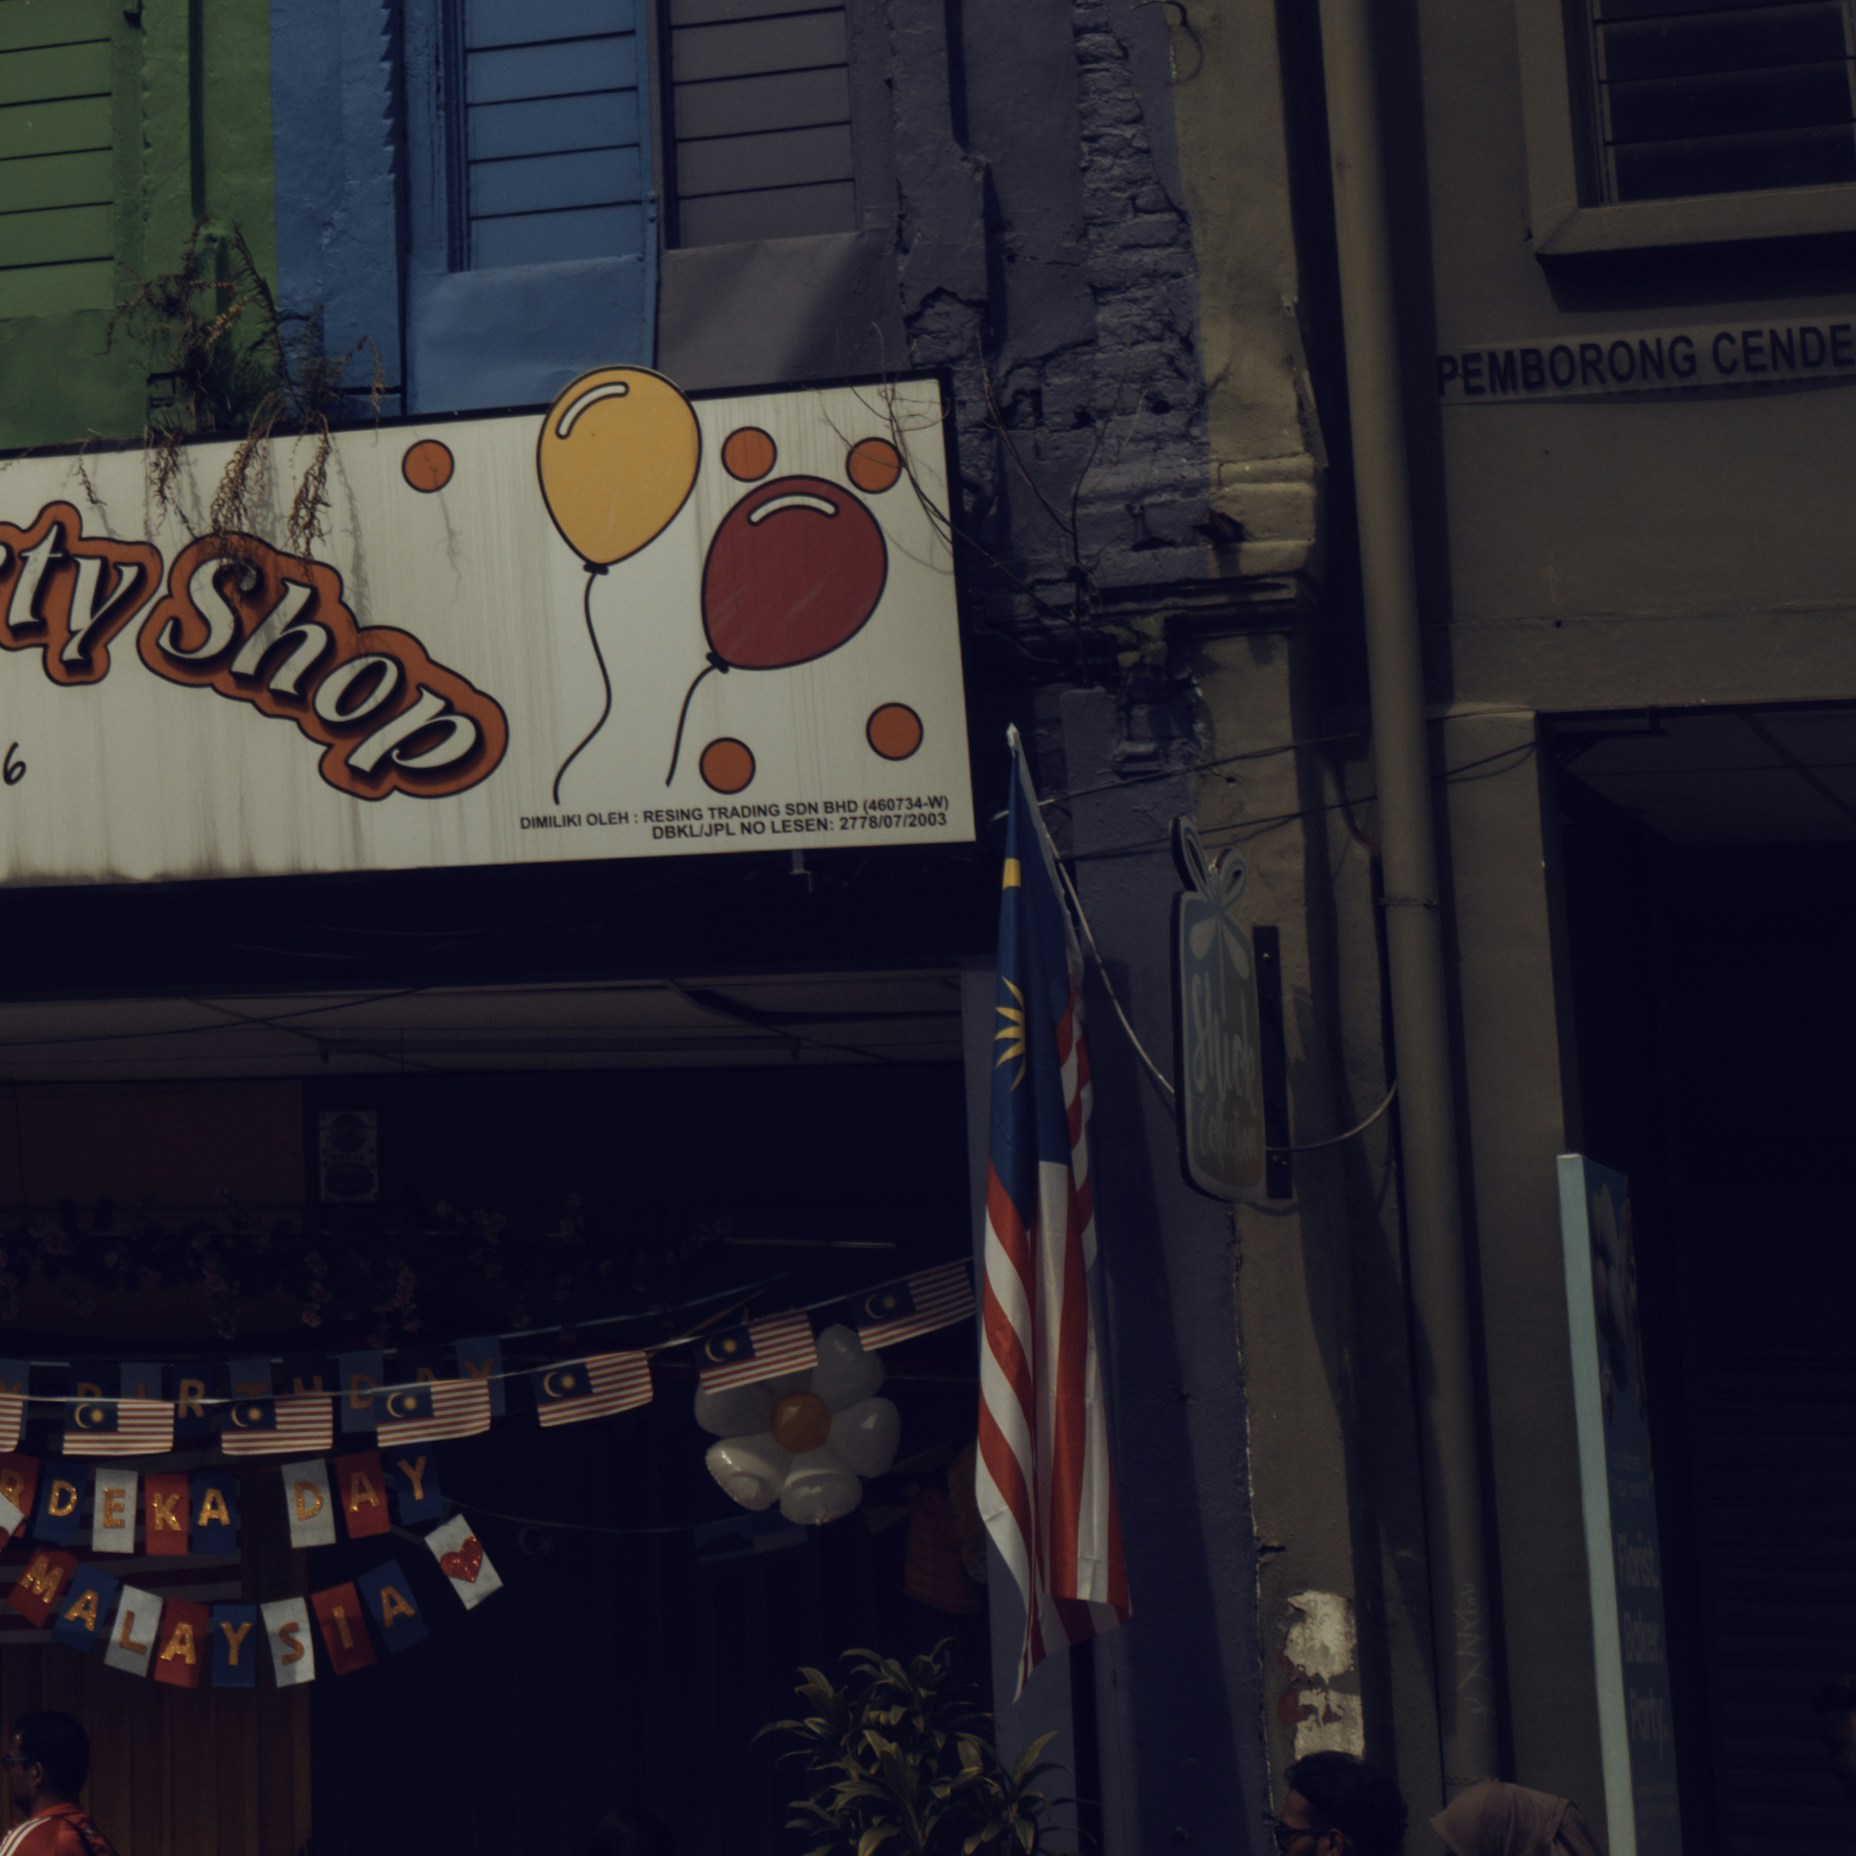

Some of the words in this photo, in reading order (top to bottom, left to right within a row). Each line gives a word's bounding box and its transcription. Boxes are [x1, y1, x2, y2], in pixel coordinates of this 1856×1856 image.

[1436, 334, 1697, 397] PEMBORONG
[156, 554, 488, 782] Shop
[520, 813, 582, 830] DIMILIKI
[586, 810, 629, 827] OLEH
[643, 807, 703, 823] RESING
[708, 804, 781, 820] TRADING
[785, 801, 820, 817] SDN
[823, 799, 858, 814] BHD
[862, 794, 949, 815] (460734-W)
[652, 822, 736, 840] DBKL/JPL
[740, 821, 767, 836] NO
[771, 817, 835, 835] LESEN:
[839, 812, 948, 831] 2778/07/2003
[294, 1455, 427, 1522] DAY
[20, 1556, 416, 1667] MALAYSIA
